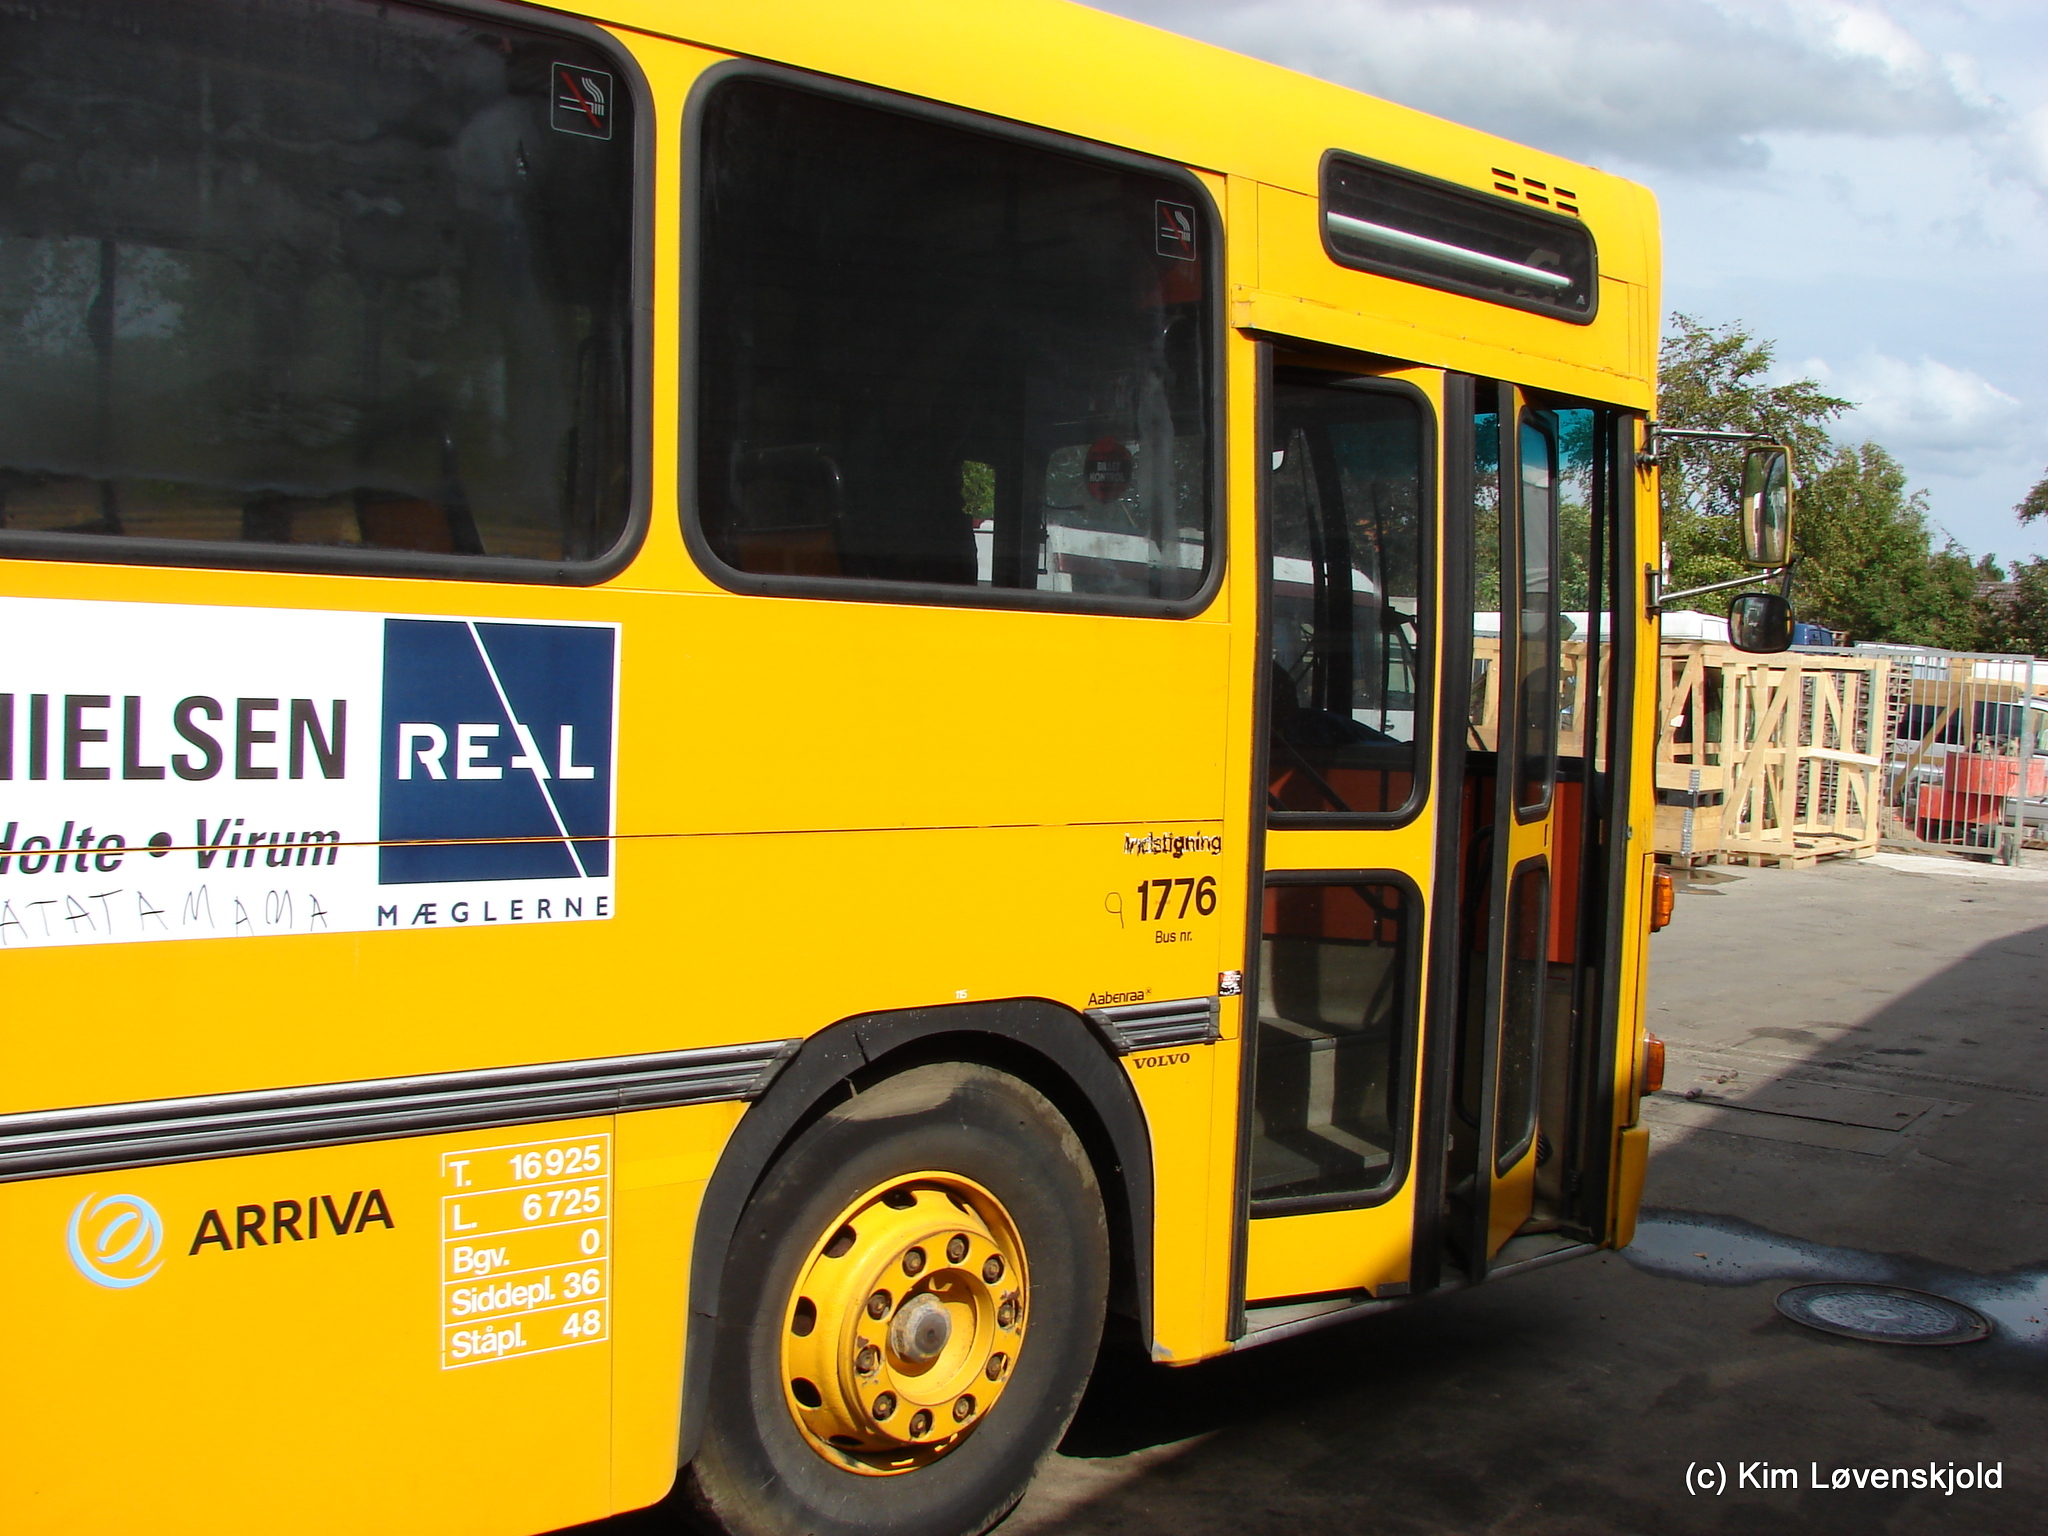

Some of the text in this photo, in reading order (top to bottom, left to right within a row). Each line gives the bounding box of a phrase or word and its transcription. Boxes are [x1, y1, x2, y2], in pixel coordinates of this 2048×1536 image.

[0, 693, 347, 781] IELSEN
[398, 722, 595, 780] REAL
[196, 818, 340, 869] Virum
[1124, 830, 1222, 859] Indstigning
[377, 896, 609, 927] MÆGLERNE
[1137, 875, 1217, 922] 1776
[1155, 930, 1193, 944] Bus nr.
[1133, 1052, 1190, 1069] VOLVO
[449, 1160, 472, 1187] T.
[188, 1189, 394, 1256] ARRIVA
[453, 1204, 478, 1231] L.
[453, 1228, 600, 1275] Bgv. 0
[452, 1268, 600, 1316] Siddepl. 36
[452, 1309, 601, 1356] Ståpl. 48
